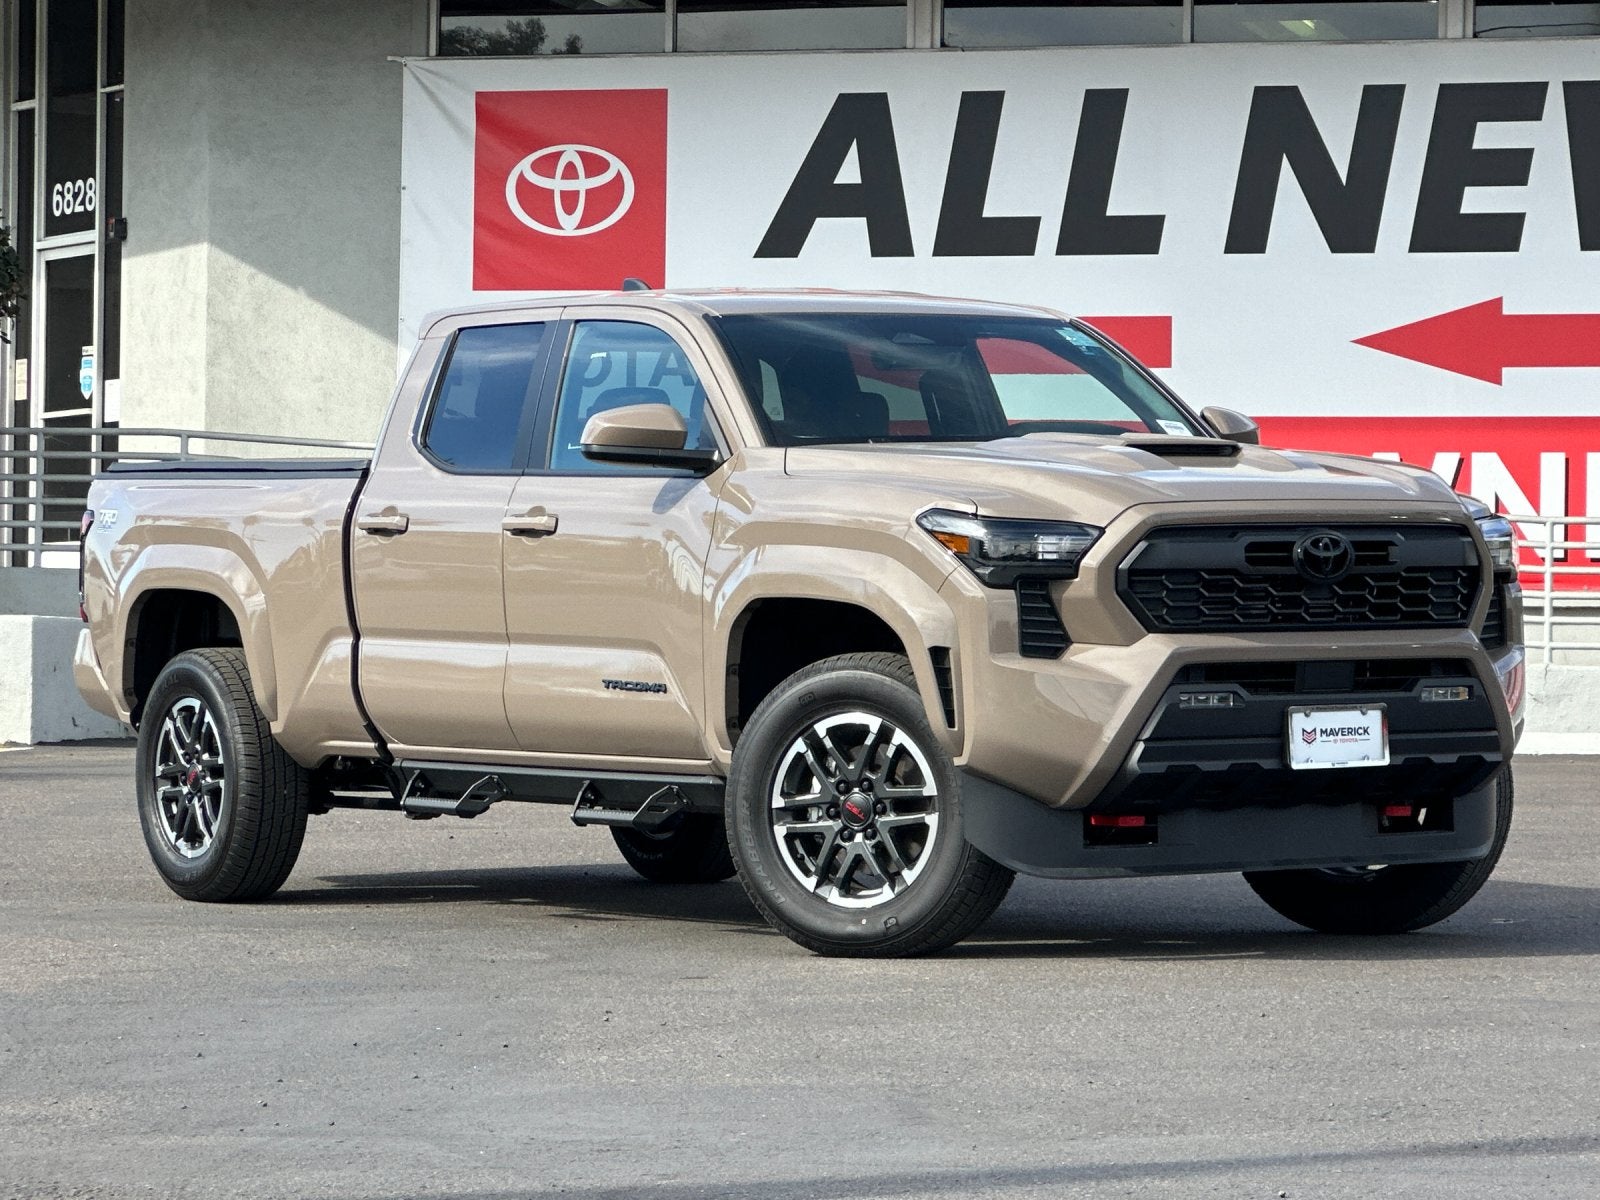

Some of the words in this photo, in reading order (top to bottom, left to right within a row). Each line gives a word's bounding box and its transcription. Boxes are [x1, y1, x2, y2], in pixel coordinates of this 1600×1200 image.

[753, 88, 1166, 258] ALL
[1223, 80, 1600, 254] NE
[53, 177, 96, 217] 6828
[601, 679, 667, 694] TACOMA
[1319, 726, 1370, 738] MAVERICK
